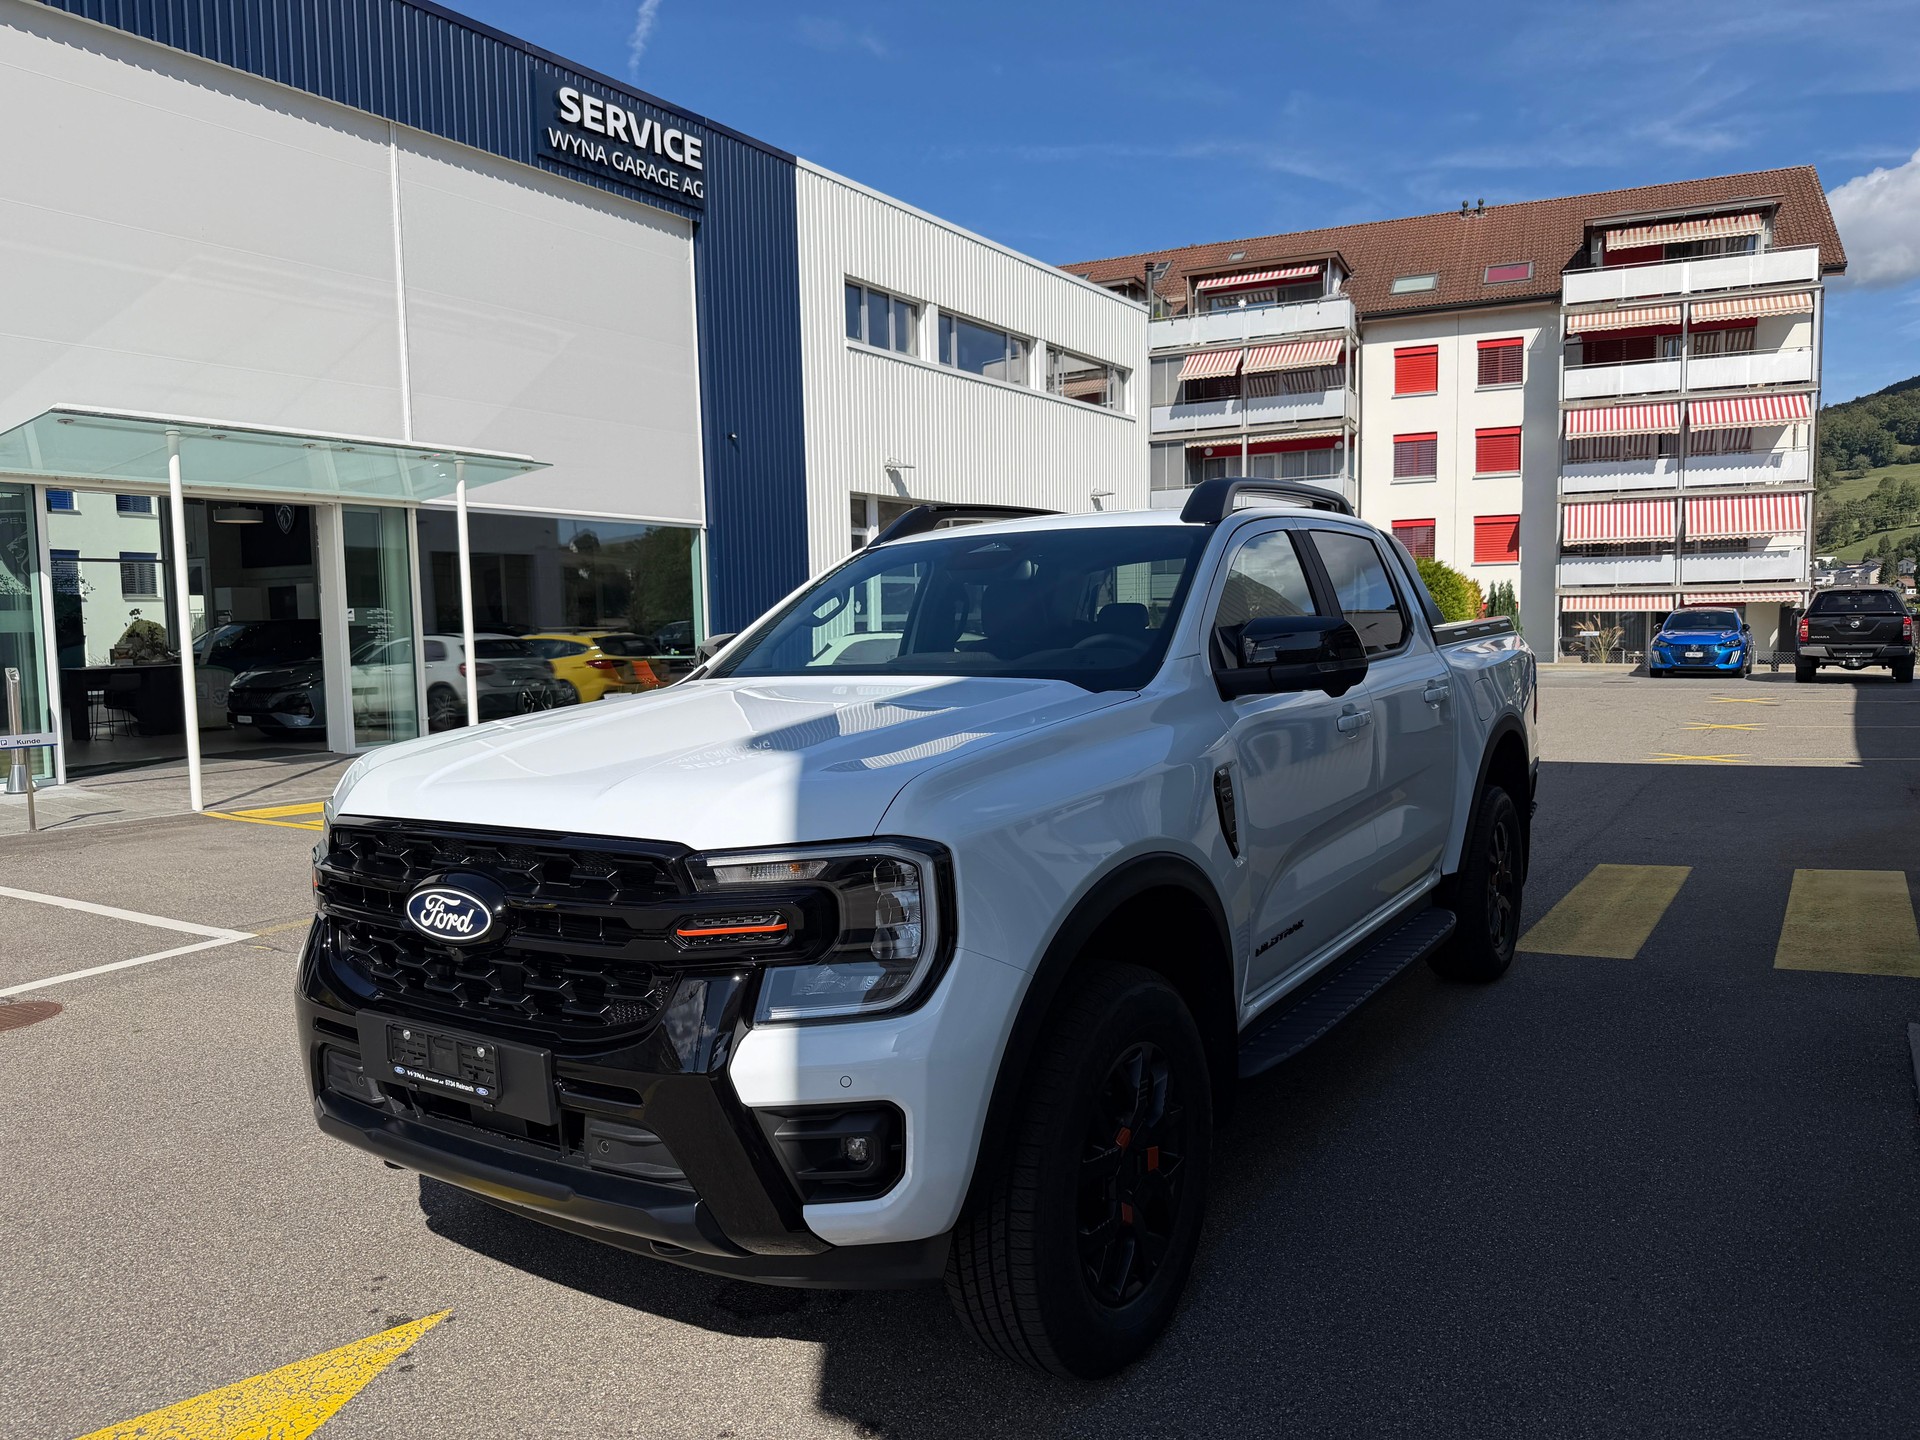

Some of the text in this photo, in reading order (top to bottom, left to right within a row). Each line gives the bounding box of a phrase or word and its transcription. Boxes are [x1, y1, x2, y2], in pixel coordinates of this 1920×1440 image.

[559, 86, 703, 170] SERVICE
[548, 126, 704, 199] WYNA GARAGE AG
[420, 894, 475, 933] Ford
[406, 1070, 425, 1080] WYNA
[455, 1082, 474, 1093] Reinach
